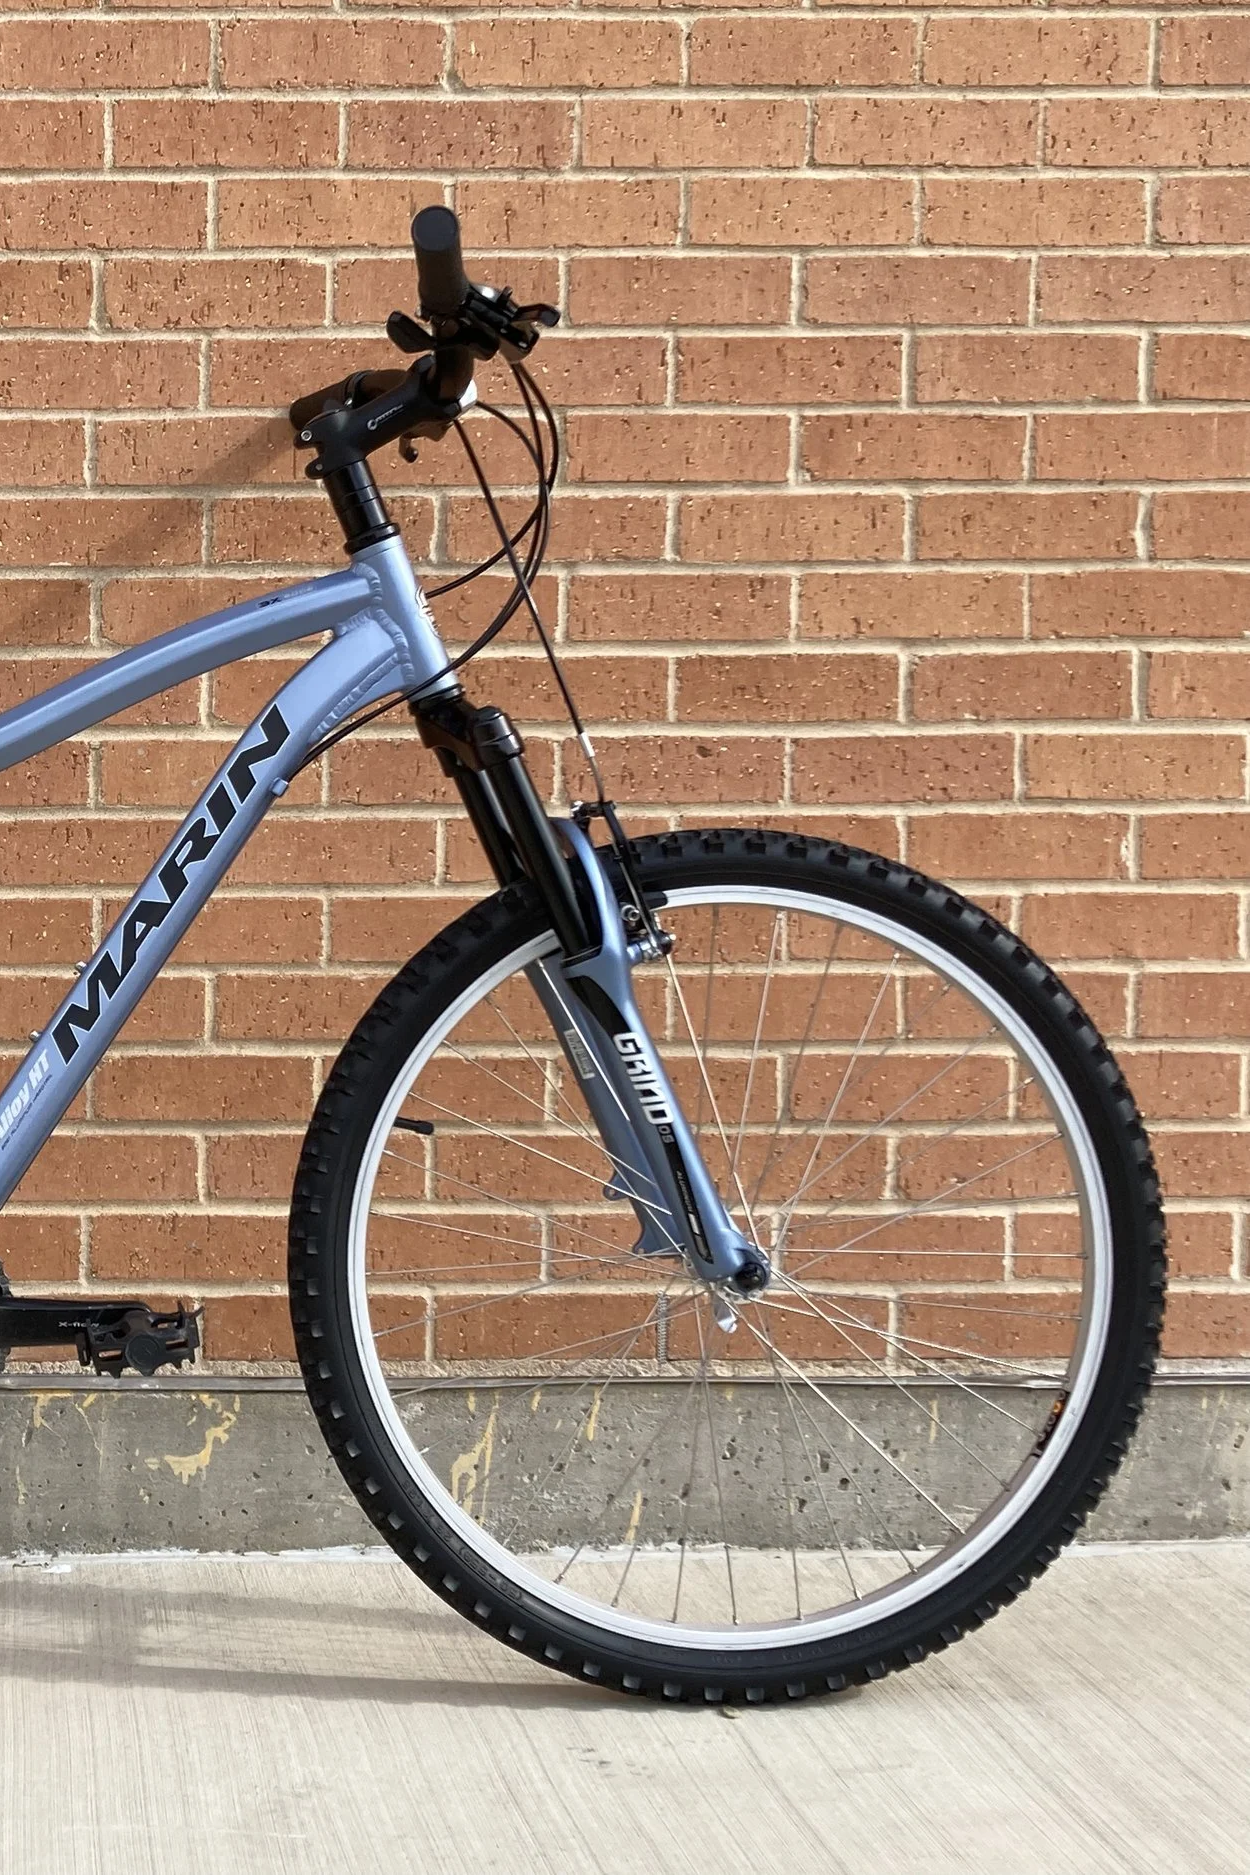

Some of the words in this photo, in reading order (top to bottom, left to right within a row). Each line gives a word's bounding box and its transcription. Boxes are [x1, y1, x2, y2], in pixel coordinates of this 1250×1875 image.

[52, 703, 290, 1065] MARIN
[28, 1049, 50, 1089] HT
[613, 1031, 674, 1124] GRIND
